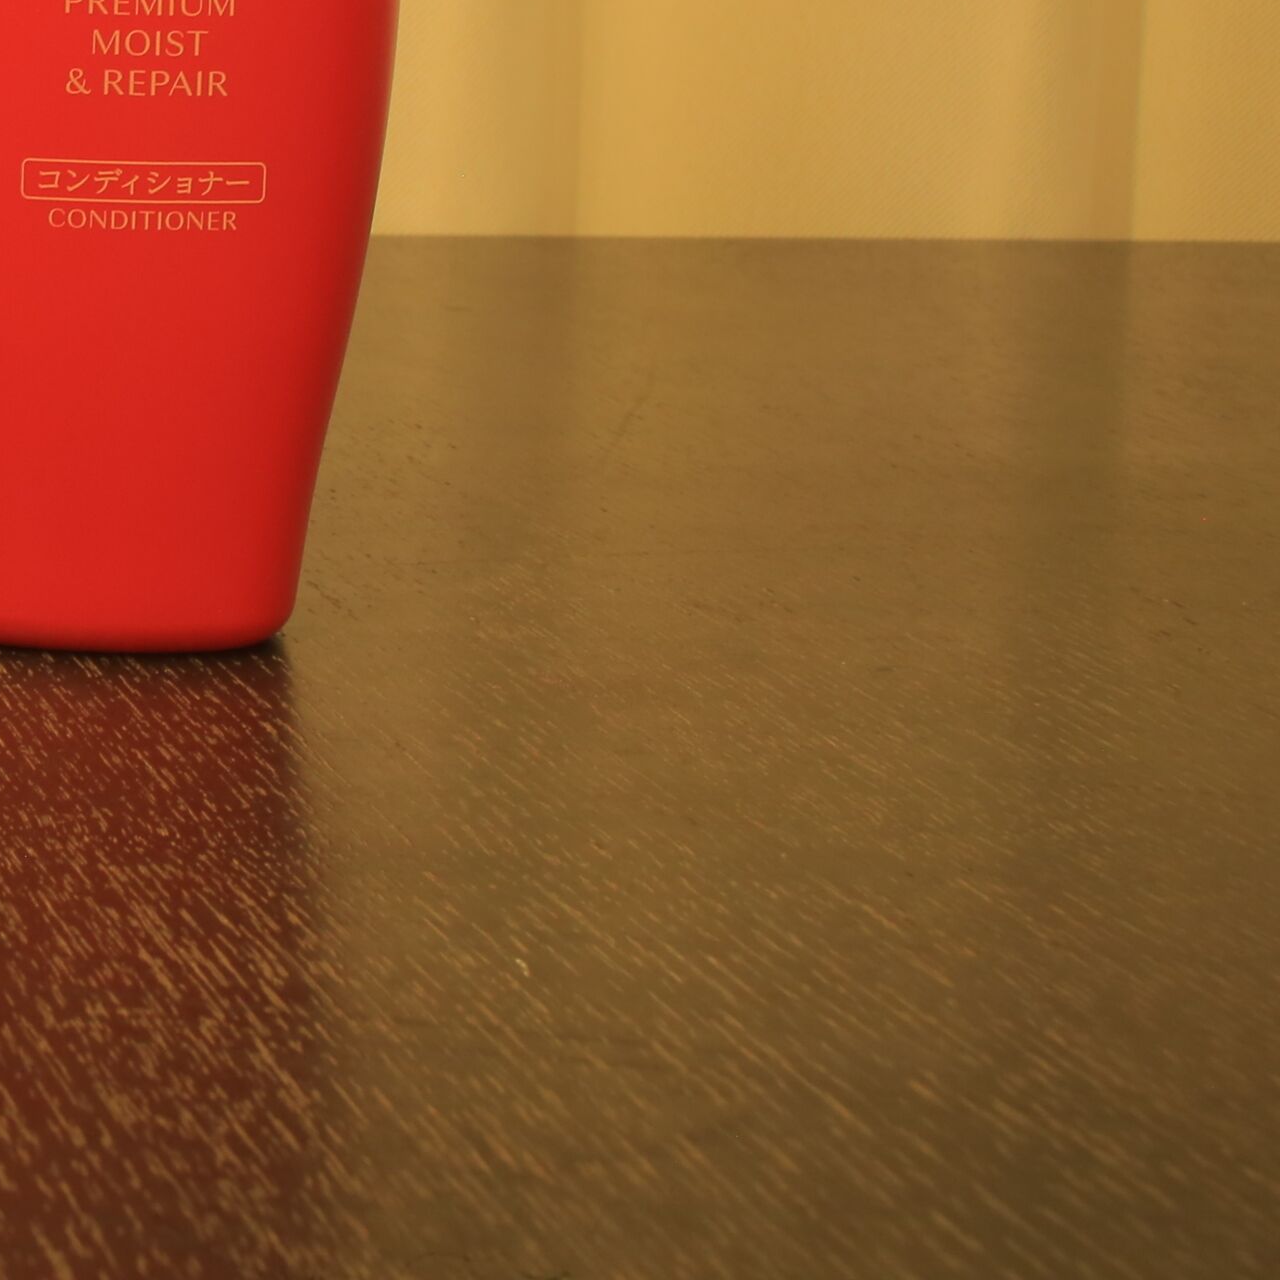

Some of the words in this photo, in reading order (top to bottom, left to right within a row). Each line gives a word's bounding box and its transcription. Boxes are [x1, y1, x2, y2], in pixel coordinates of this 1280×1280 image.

[91, 28, 209, 57] MOIST
[65, 67, 91, 95] &
[103, 69, 228, 97] REPAIR
[37, 167, 251, 197] コンディショナー
[48, 207, 238, 232] CONDITIONER
